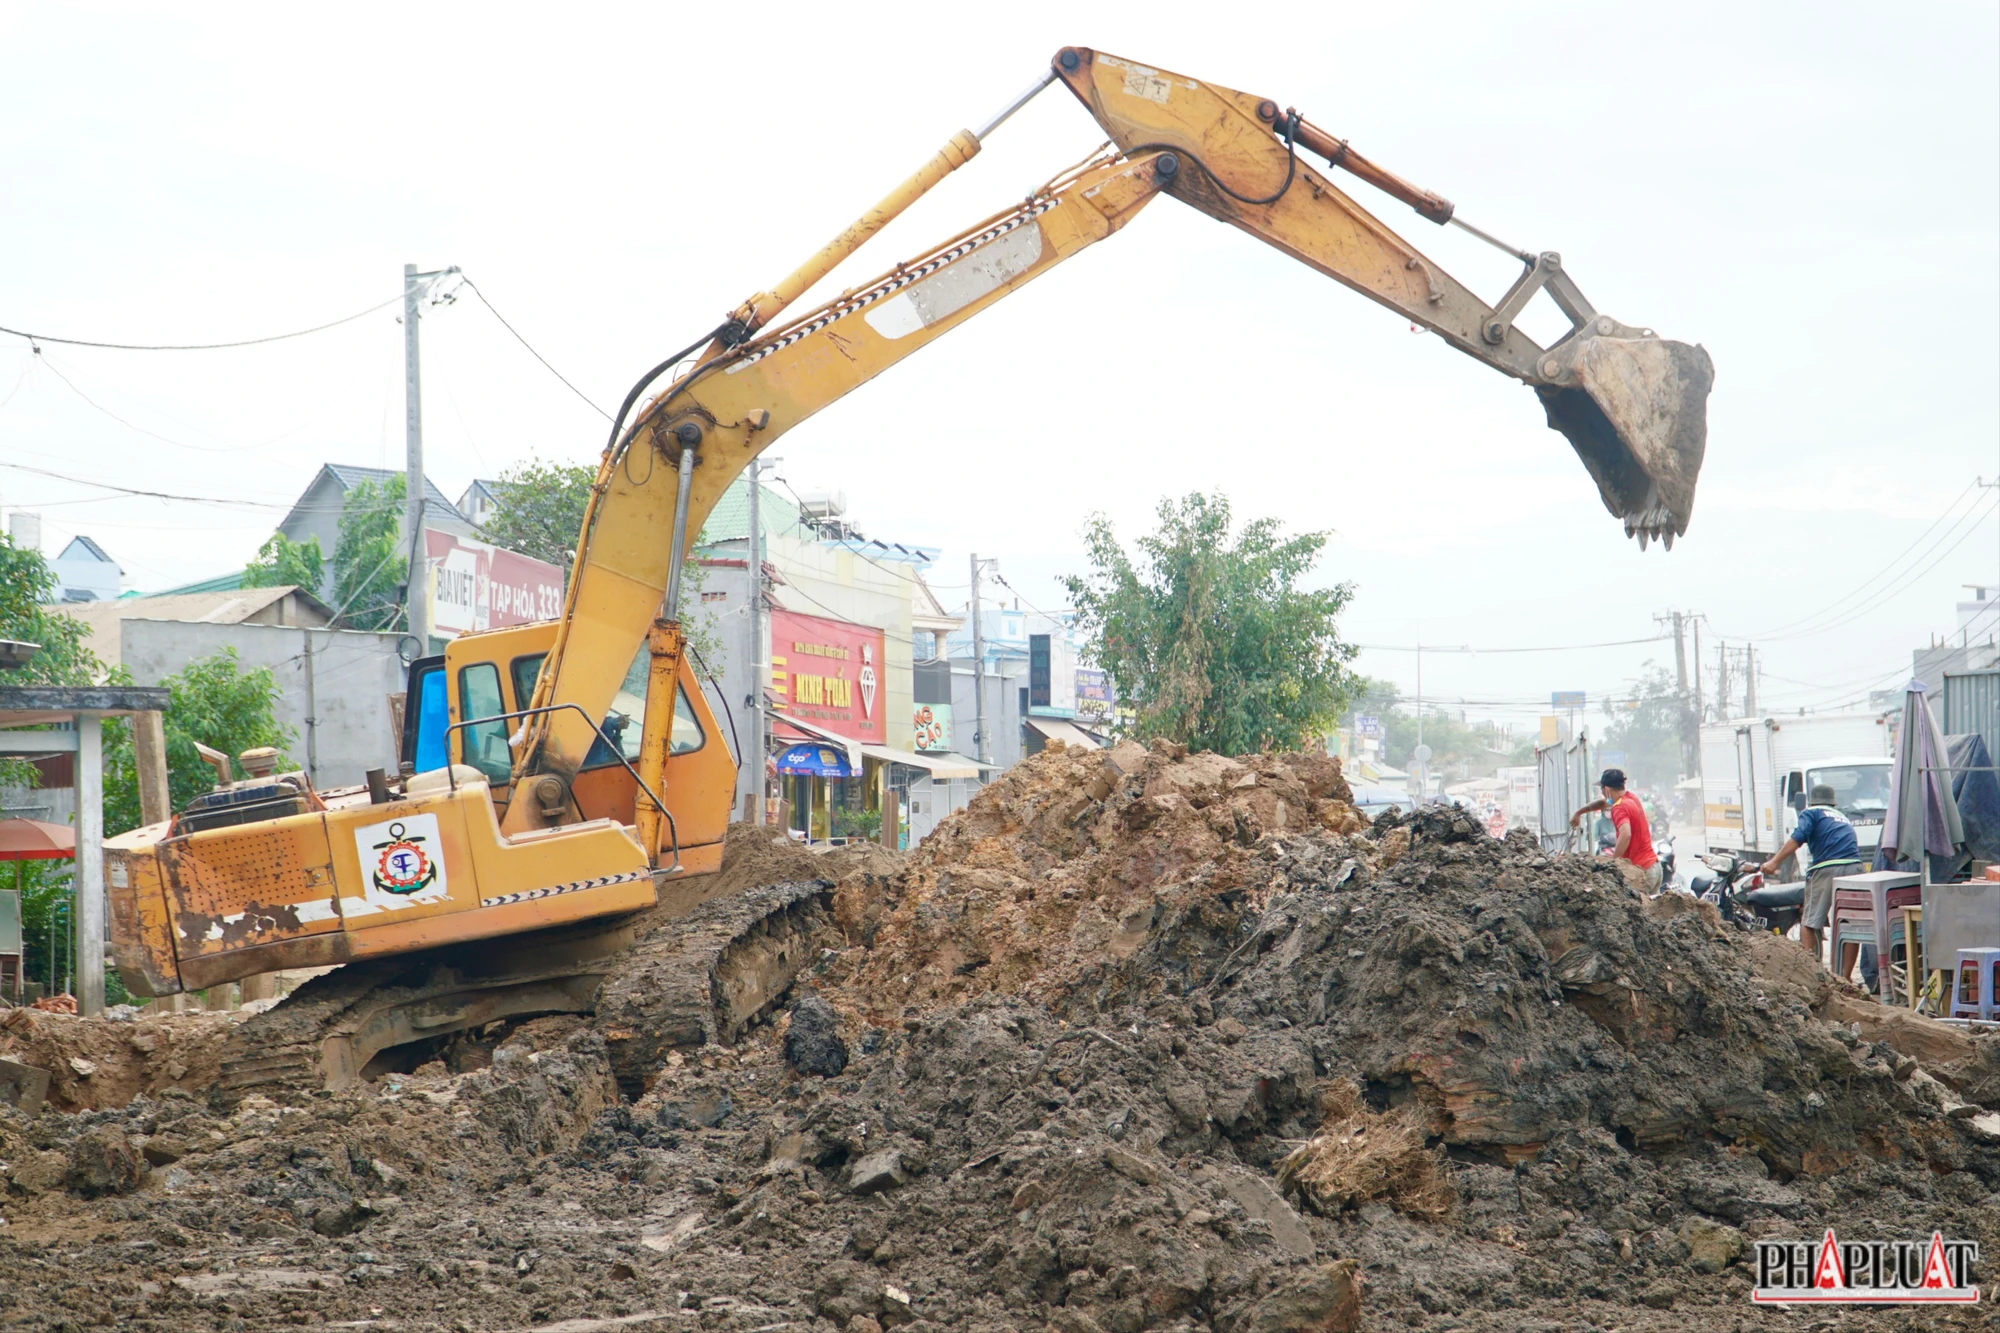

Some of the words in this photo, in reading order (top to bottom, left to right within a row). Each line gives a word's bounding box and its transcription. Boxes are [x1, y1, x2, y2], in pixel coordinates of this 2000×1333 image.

[491, 581, 511, 619] TẠP
[513, 583, 535, 620] HÓA
[538, 584, 560, 620] 333
[796, 673, 823, 705] MINH
[825, 666, 851, 708] TUẤN
